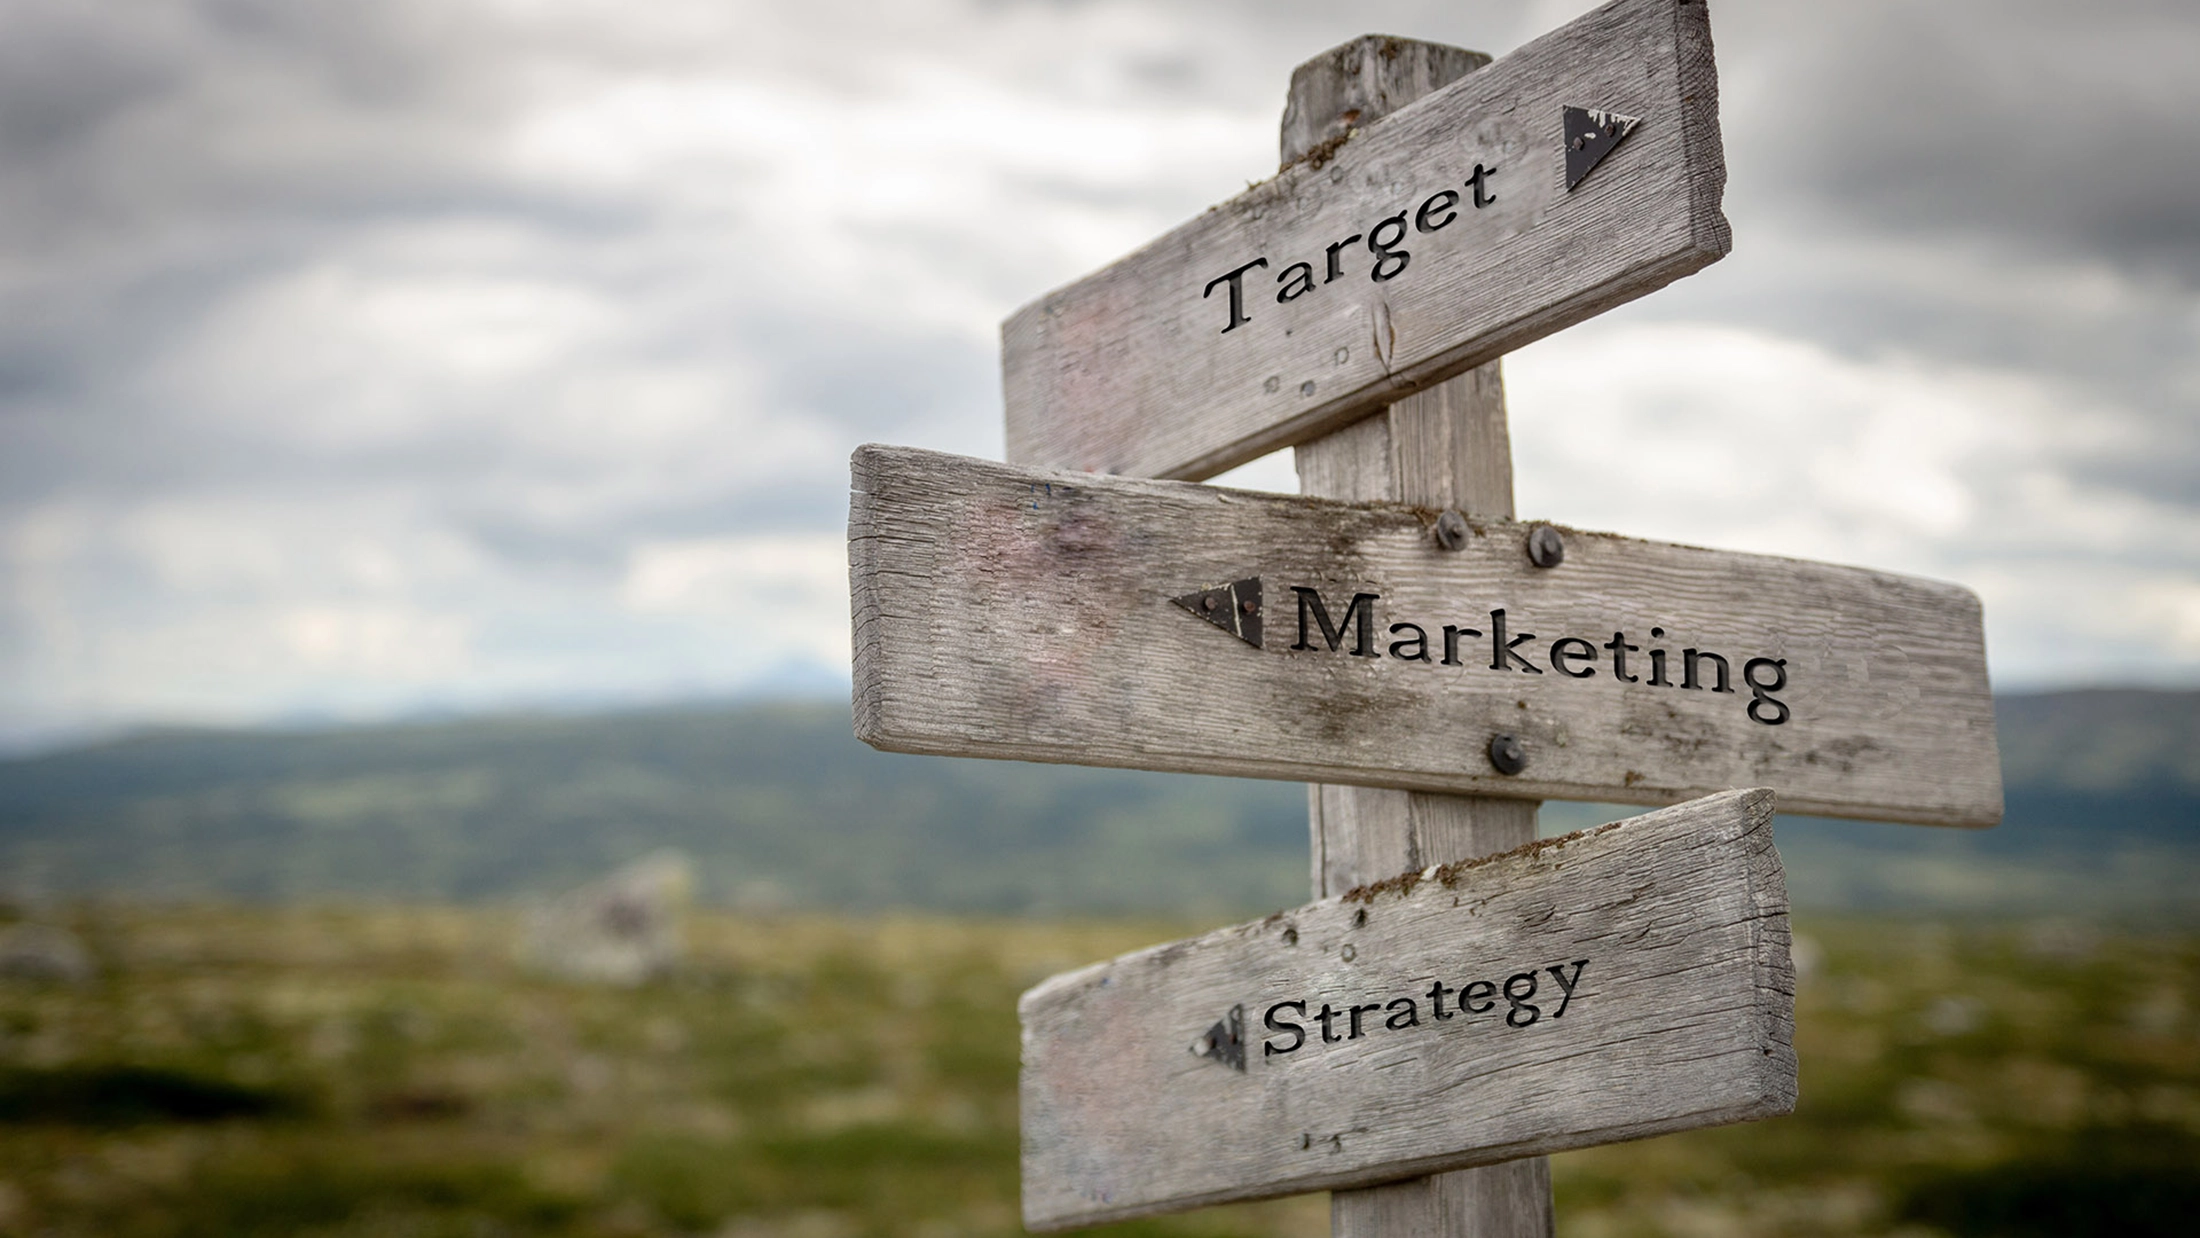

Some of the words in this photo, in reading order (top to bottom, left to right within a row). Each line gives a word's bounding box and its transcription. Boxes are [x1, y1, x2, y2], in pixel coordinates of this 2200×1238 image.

[1203, 162, 1498, 335] Target
[1289, 585, 1791, 727] Marketing
[1264, 958, 1590, 1058] Strategy
